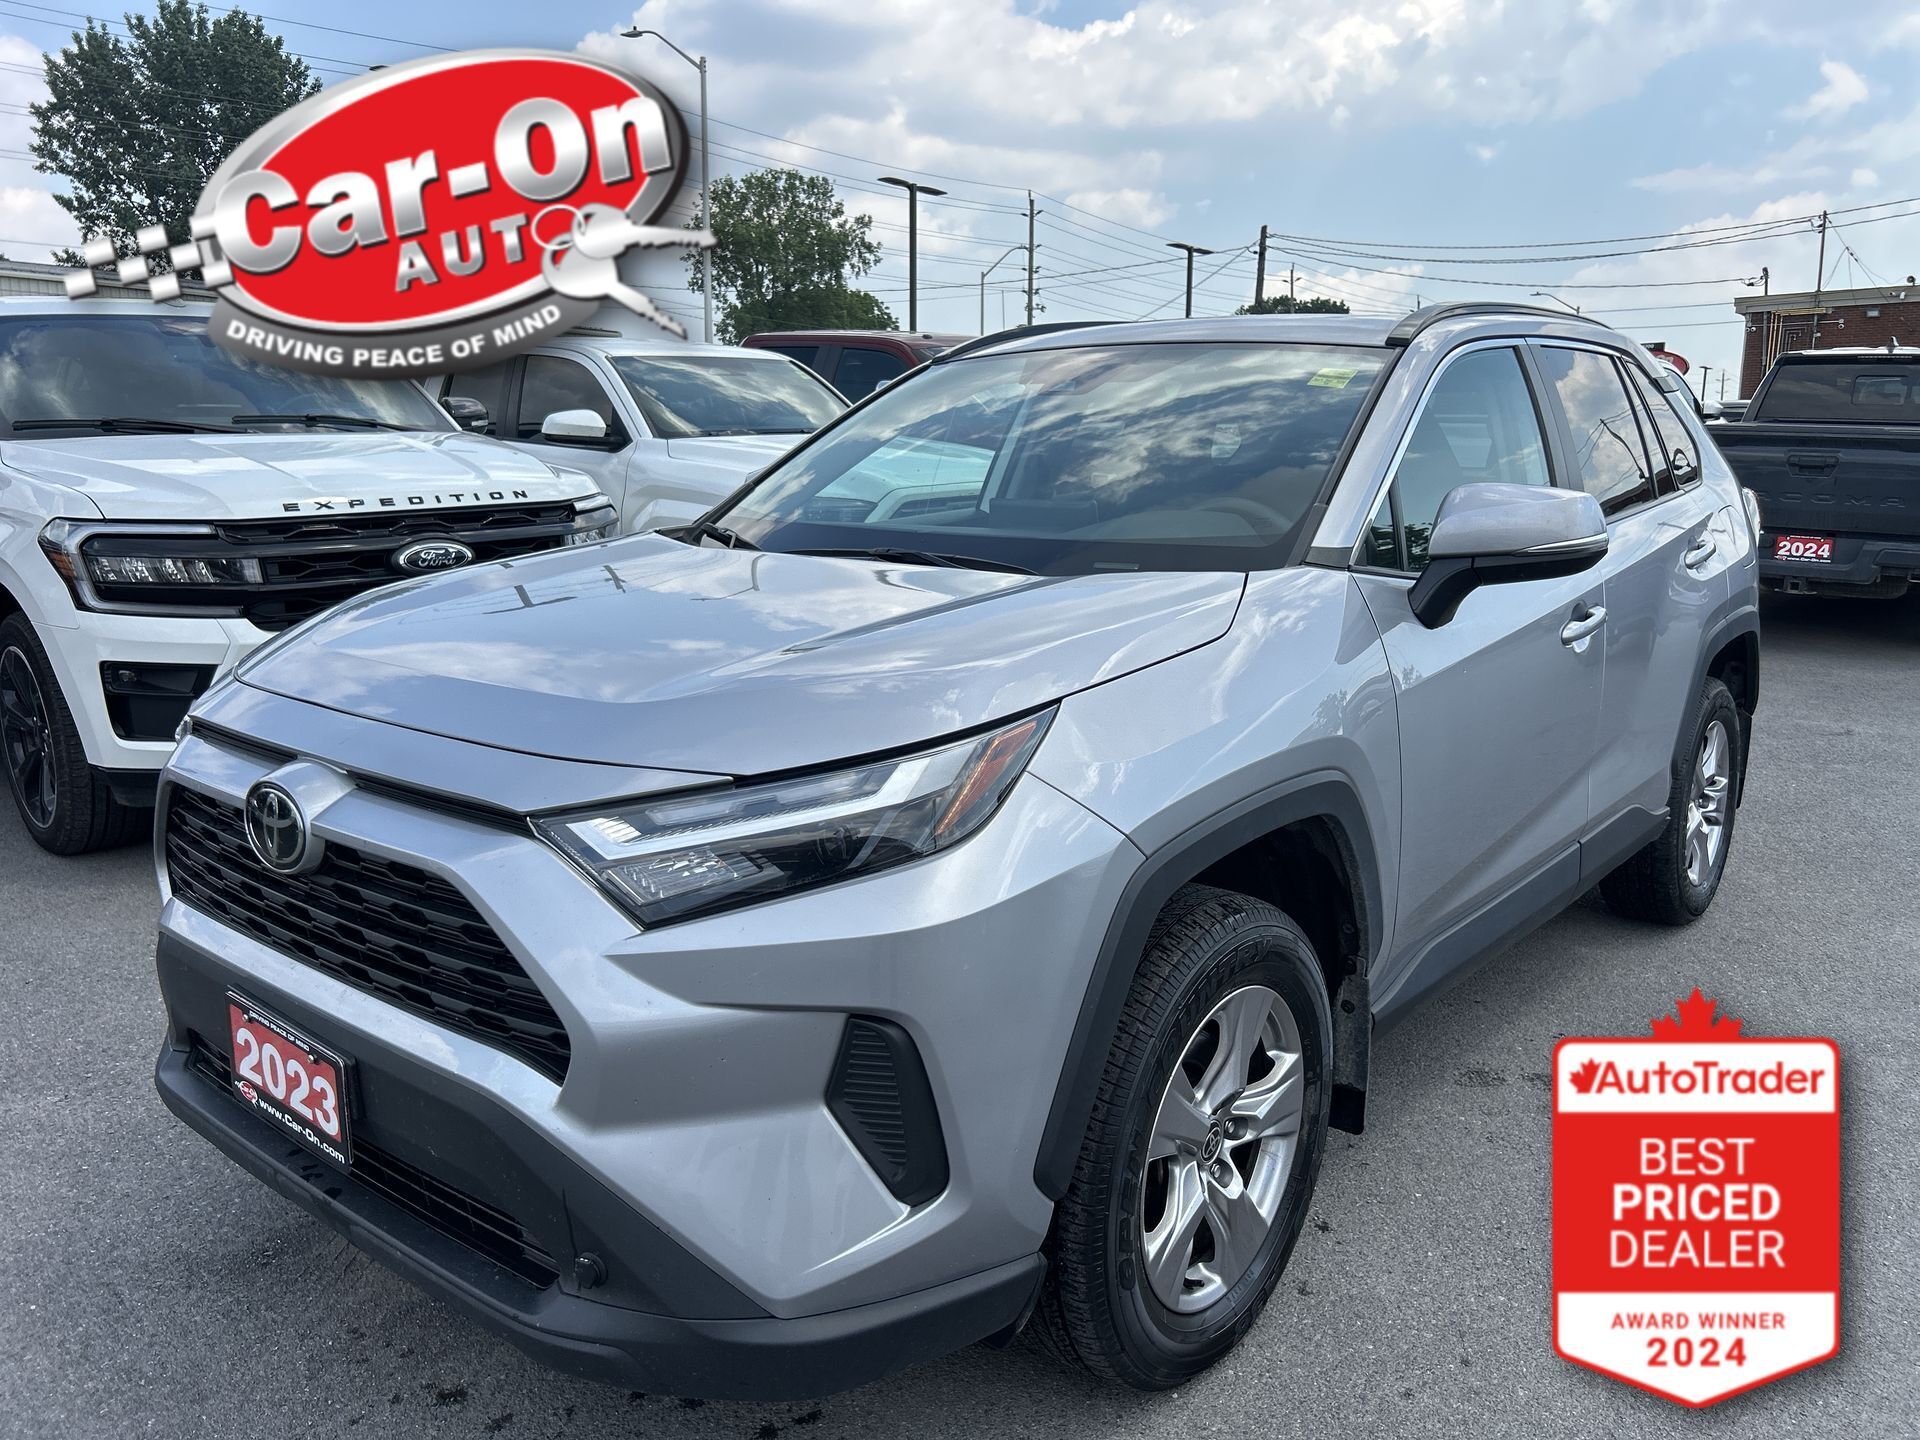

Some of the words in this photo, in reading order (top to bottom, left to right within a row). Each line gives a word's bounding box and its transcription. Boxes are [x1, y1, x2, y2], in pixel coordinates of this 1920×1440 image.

[282, 490, 528, 512] EXPEDITION
[418, 548, 457, 568] Ford
[1777, 541, 1830, 558] 2024
[236, 1027, 340, 1137] 2023
[258, 1098, 346, 1164] www.Car-On.com
